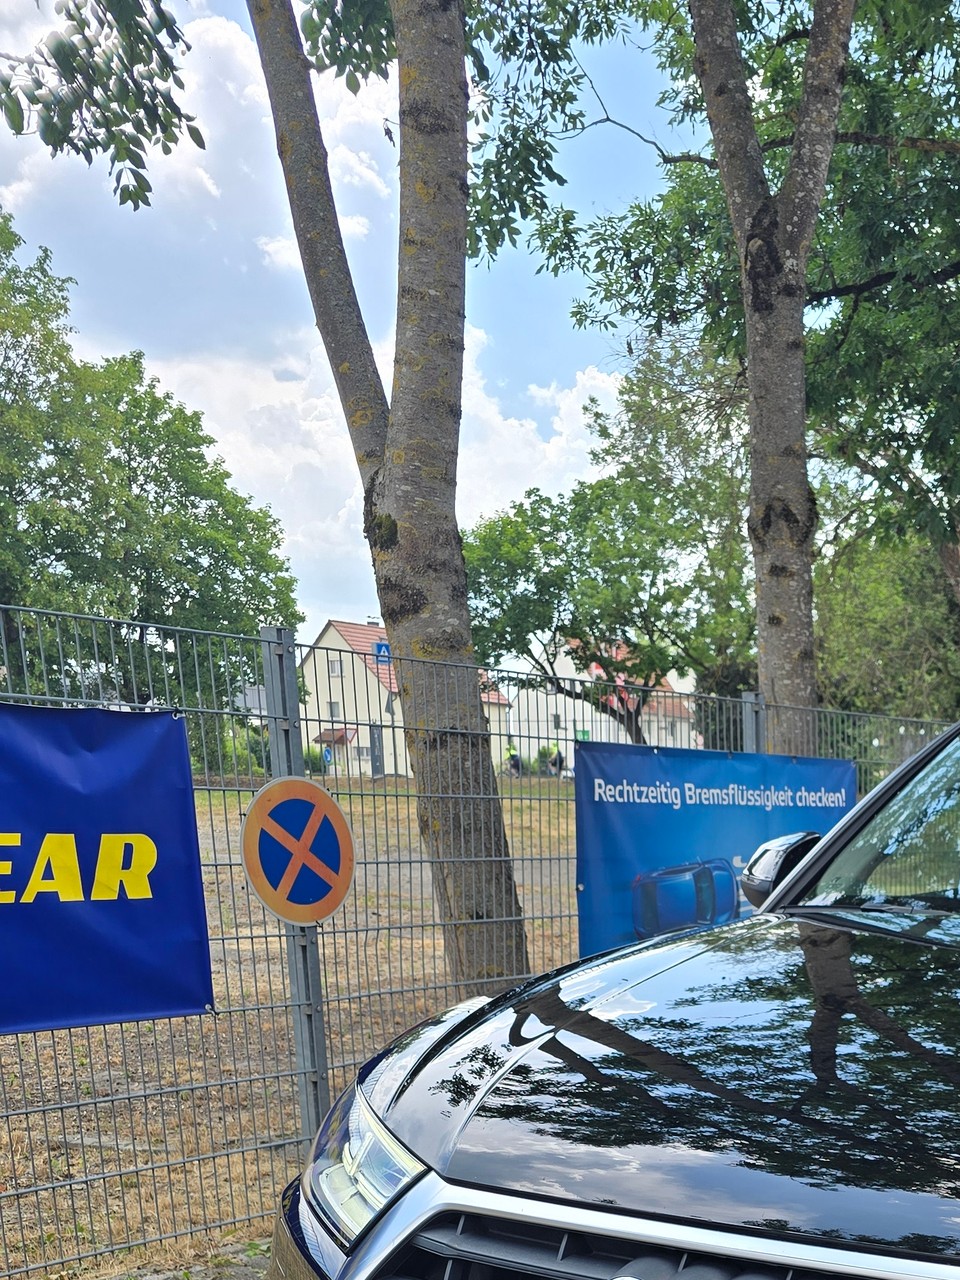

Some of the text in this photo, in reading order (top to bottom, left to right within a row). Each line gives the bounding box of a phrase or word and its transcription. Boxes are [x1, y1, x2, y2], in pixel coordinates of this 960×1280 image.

[594, 778, 846, 811] Rechtzeitig Bremsflüssigkeit checken!
